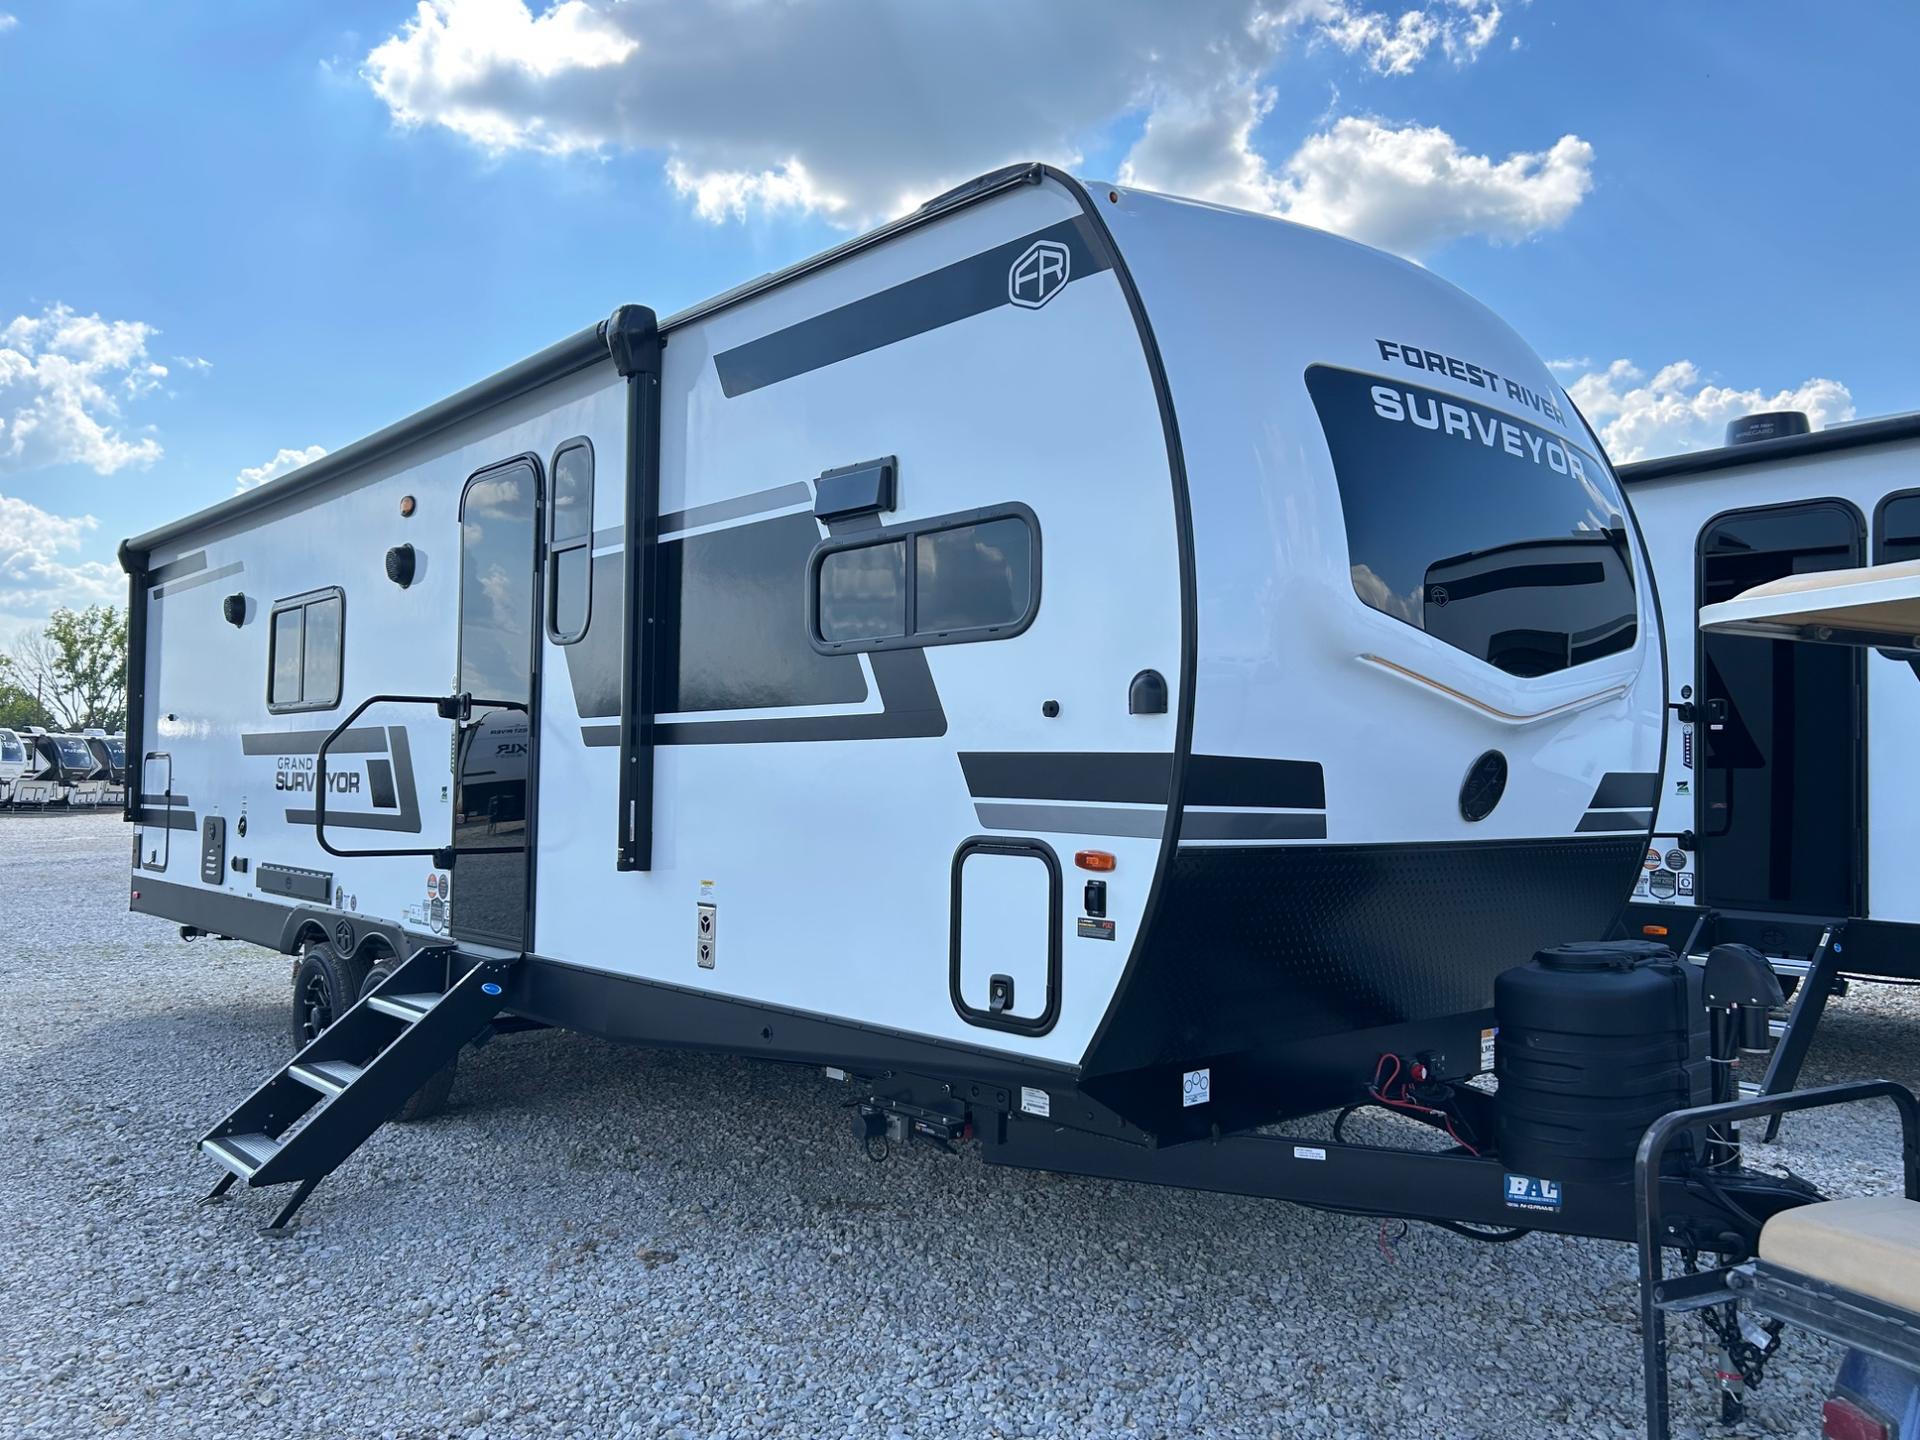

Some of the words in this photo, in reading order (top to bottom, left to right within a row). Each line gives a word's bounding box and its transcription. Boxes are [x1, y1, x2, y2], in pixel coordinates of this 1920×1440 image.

[1375, 339, 1499, 392] FOREST
[1503, 378, 1567, 428] RIVER
[1370, 385, 1584, 480] SURVEYOR
[277, 757, 313, 770] GRAND
[276, 771, 360, 793] SURVYOR
[1508, 1176, 1558, 1198] BAL
